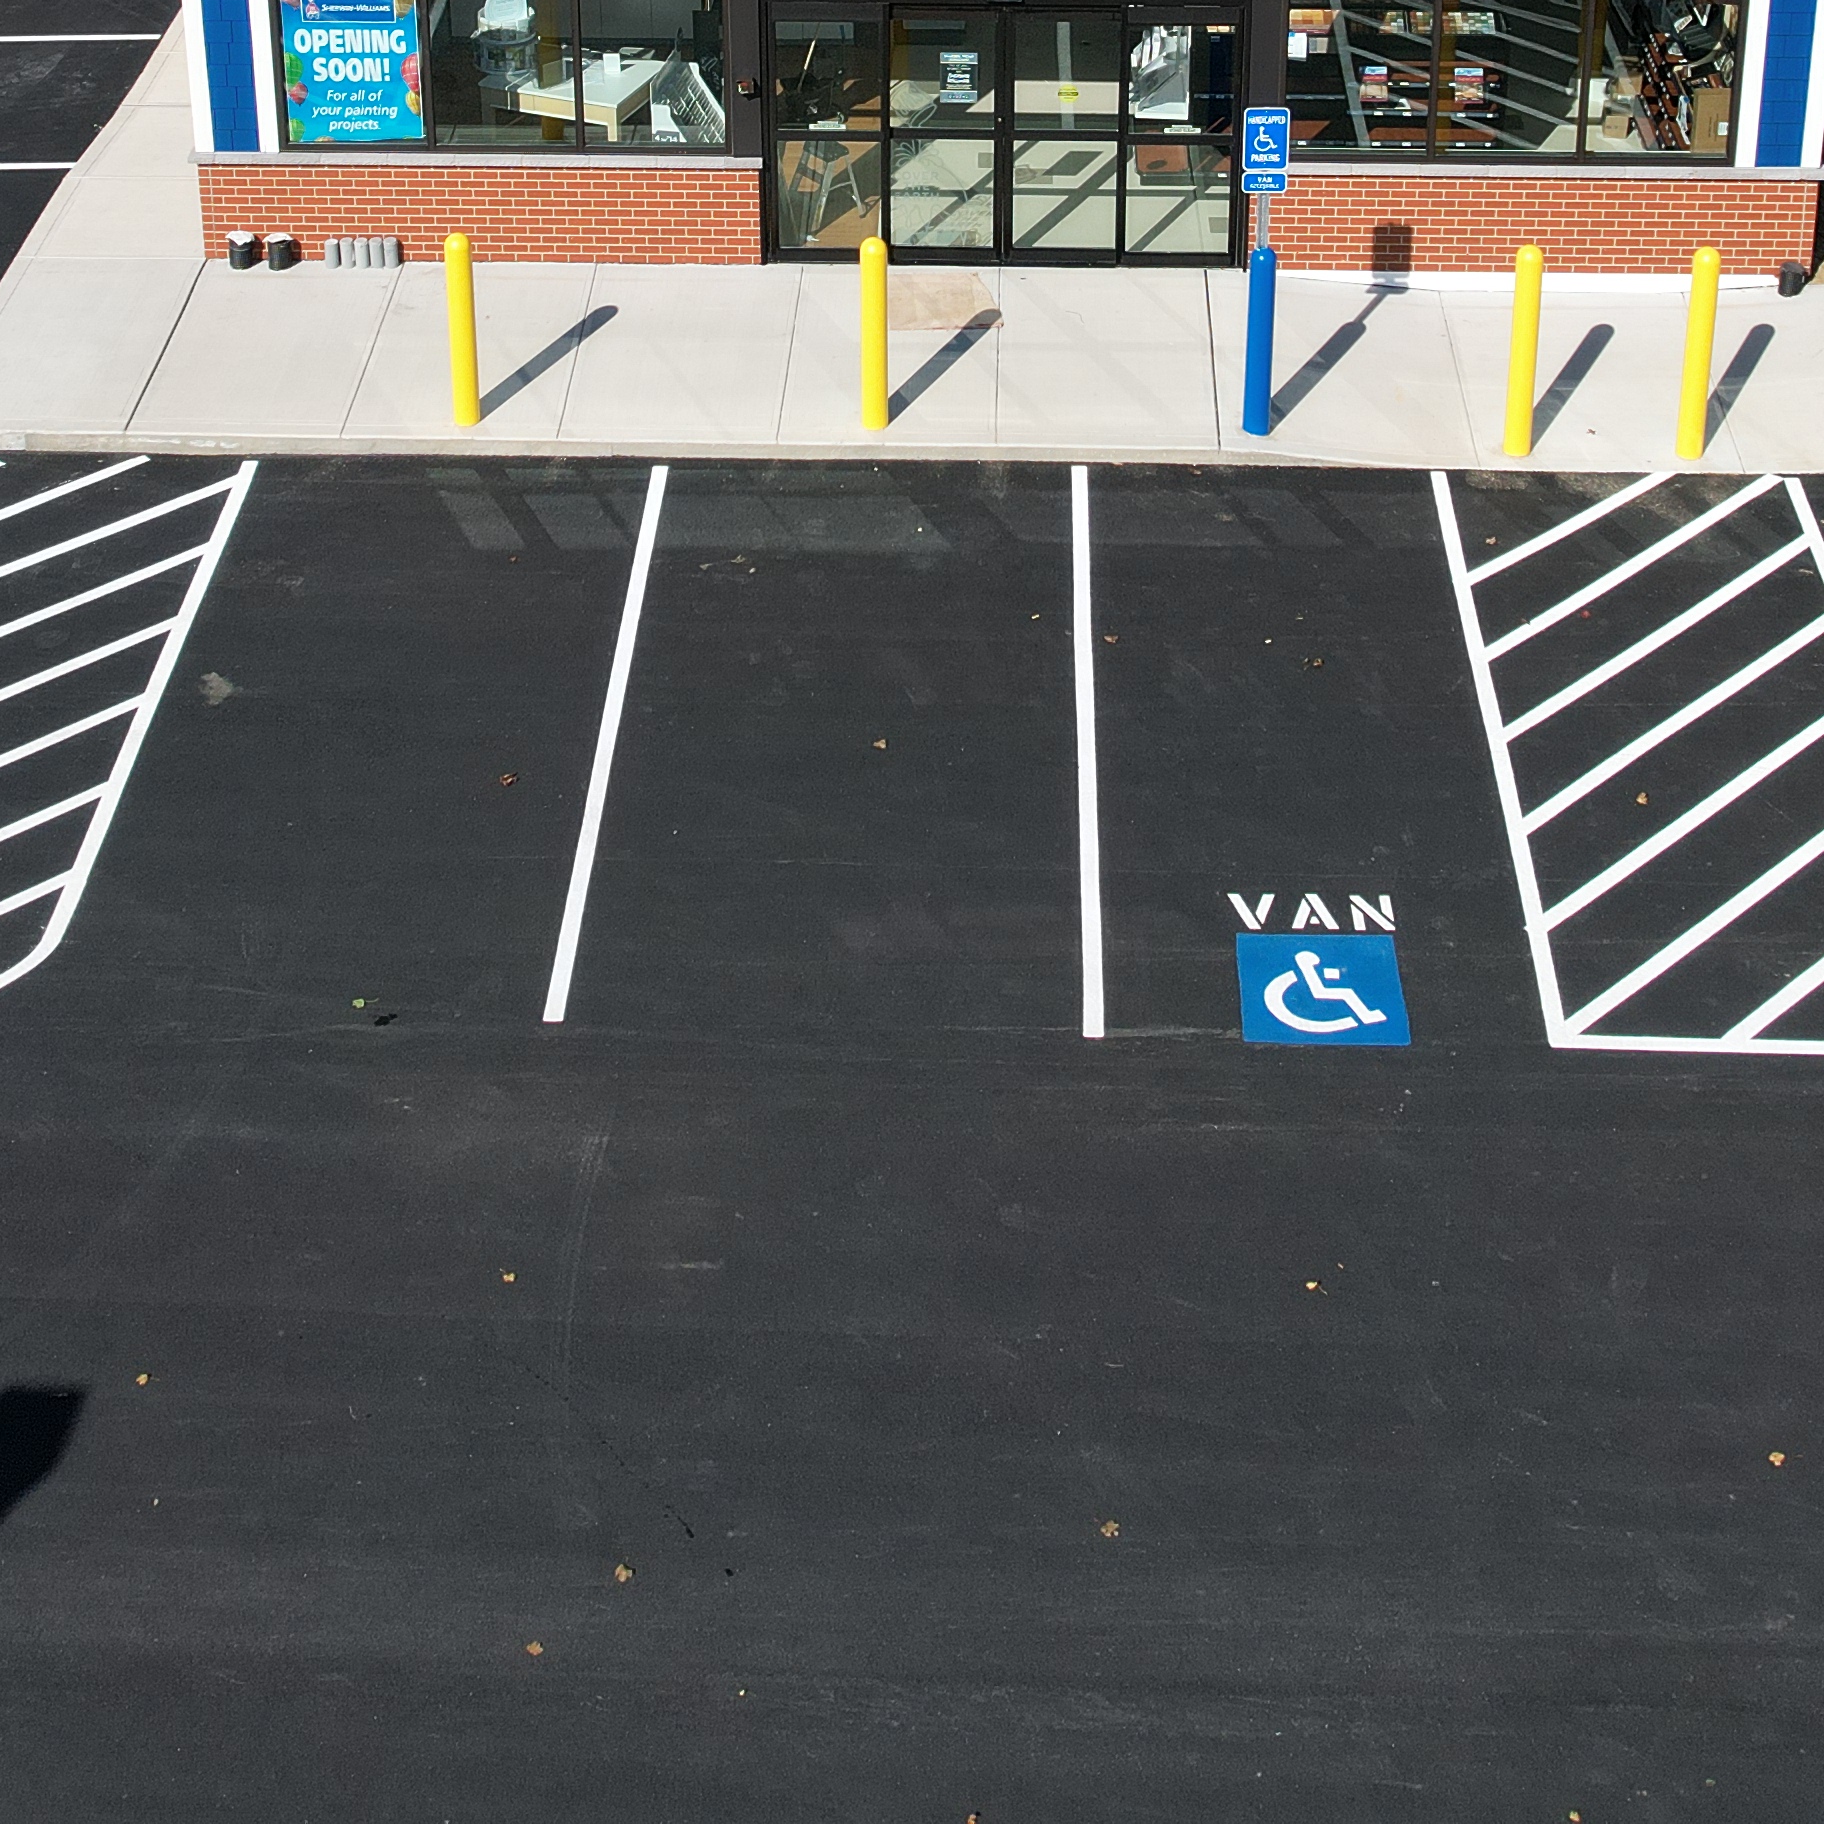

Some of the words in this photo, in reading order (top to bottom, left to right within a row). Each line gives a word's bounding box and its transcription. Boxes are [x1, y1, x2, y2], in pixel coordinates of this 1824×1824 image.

[293, 28, 407, 54] OPENING
[312, 57, 391, 82] SOON!
[327, 89, 347, 102] For
[349, 89, 365, 102] all
[368, 89, 384, 102] of
[312, 106, 343, 118] your
[344, 104, 398, 118] painting
[328, 118, 382, 132] projects.
[1251, 154, 1280, 162] PARKING
[1226, 893, 1397, 932] VAN
